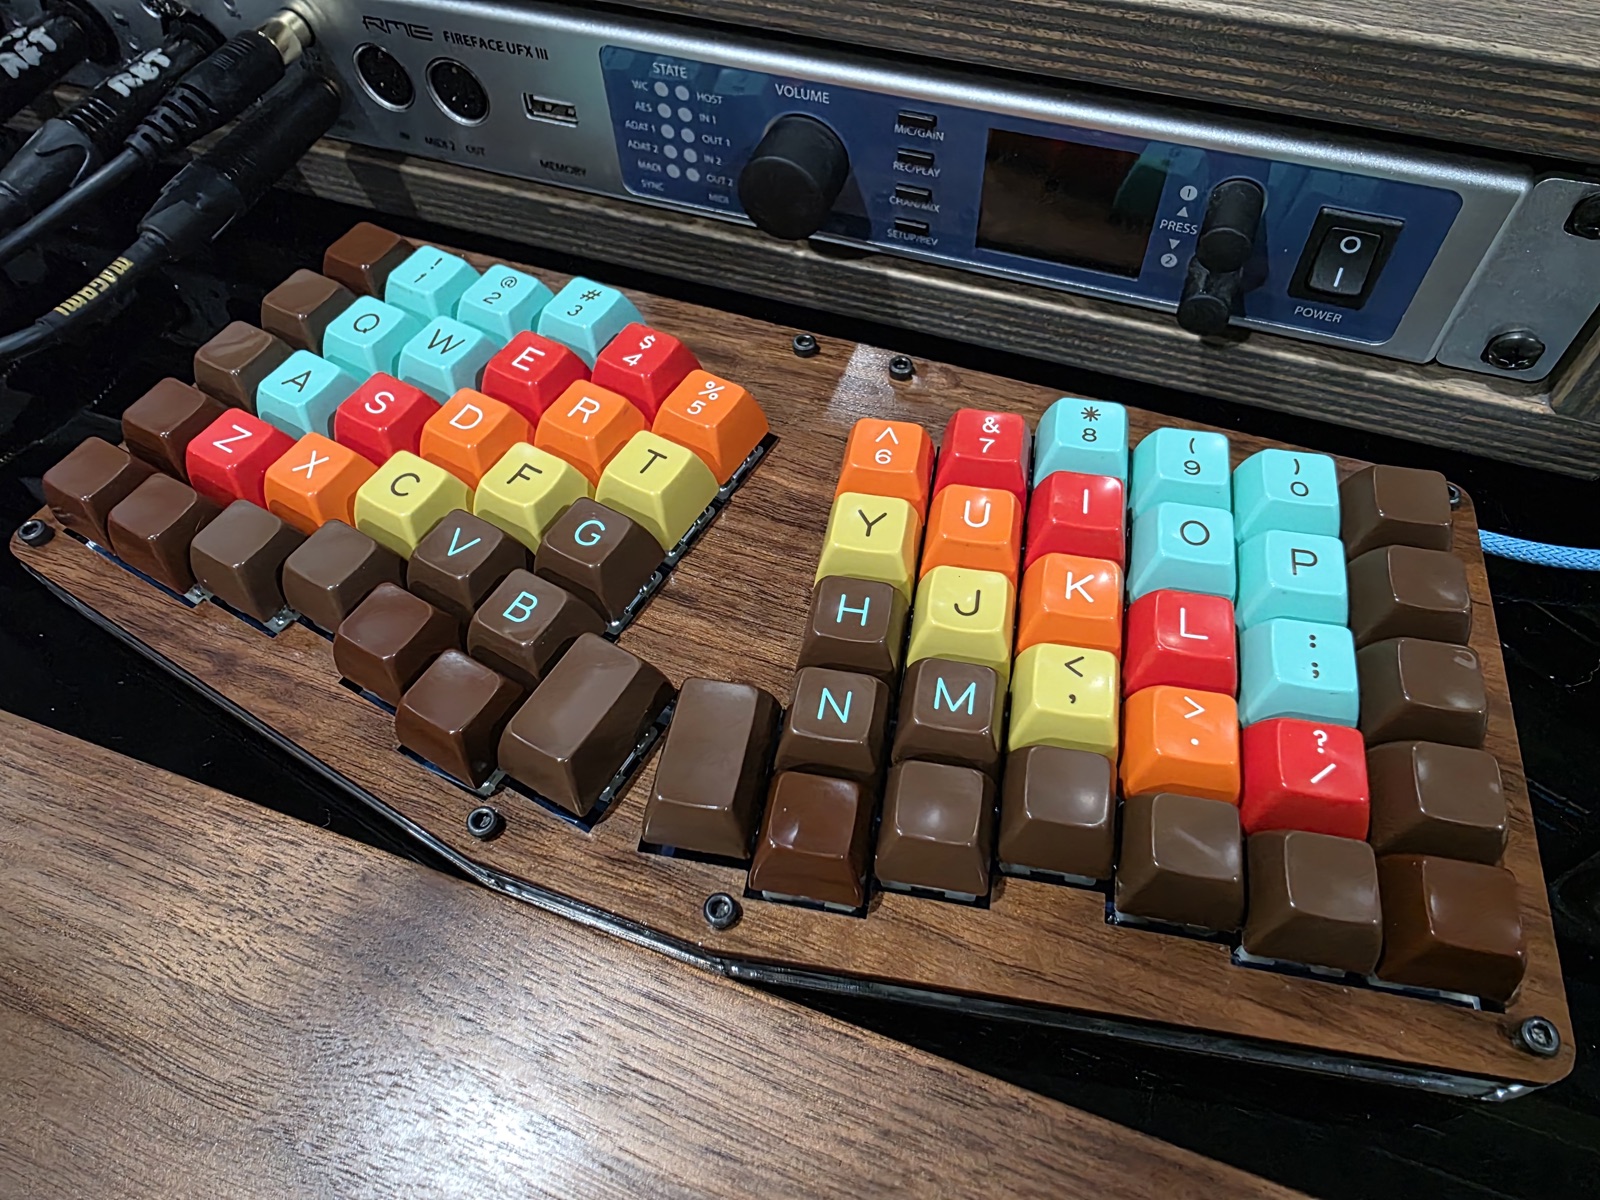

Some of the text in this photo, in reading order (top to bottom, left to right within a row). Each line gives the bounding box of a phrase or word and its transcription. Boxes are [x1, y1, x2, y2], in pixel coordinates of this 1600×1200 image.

[362, 15, 549, 61] RME FIREFACE UFX III
[652, 62, 688, 79] STATE
[631, 79, 649, 92] WC
[775, 83, 830, 104] VOLUME
[635, 101, 652, 113] AES
[696, 91, 724, 105] HOST
[699, 113, 710, 123] IN
[701, 134, 724, 146] OUT
[894, 124, 945, 142] MIC/GAIN
[539, 159, 587, 177] MEMORY
[704, 154, 715, 165] IN
[893, 160, 941, 178] REC/PLAY
[706, 174, 727, 186] OUT
[887, 228, 938, 246] SETUP/REV
[1159, 219, 1198, 235] PRESS
[500, 276, 517, 289] @
[482, 292, 502, 305] 2
[580, 289, 602, 302] #
[567, 305, 583, 317] 3
[1294, 305, 1342, 323] POWER
[353, 313, 380, 334] Q
[427, 328, 466, 355] W
[639, 334, 656, 350] $
[511, 346, 546, 371] E
[622, 353, 643, 366] 4
[281, 370, 312, 393] A
[698, 381, 725, 401] %
[364, 391, 395, 414] S
[567, 396, 600, 424] R
[687, 400, 707, 415] 5
[449, 403, 484, 430] D
[982, 416, 1001, 435] &
[212, 424, 252, 454] Z
[978, 437, 996, 454] 7
[1081, 428, 1098, 442] 8
[292, 450, 330, 479] X
[639, 448, 668, 474] T
[875, 449, 893, 465] 6
[506, 463, 543, 485] F
[1183, 460, 1201, 476] 9
[390, 472, 421, 497] C
[857, 509, 888, 538] Y
[963, 500, 991, 528] U
[447, 527, 482, 557] V
[574, 519, 606, 546] G
[1180, 520, 1210, 546] O
[1291, 548, 1318, 576] P
[1065, 571, 1095, 603] K
[502, 591, 539, 623] B
[836, 593, 870, 627] H
[953, 589, 981, 617] J
[1180, 607, 1209, 640] L
[817, 687, 853, 724] N
[933, 677, 977, 716] M
[1312, 730, 1328, 754] ?
[1310, 763, 1336, 784] /
